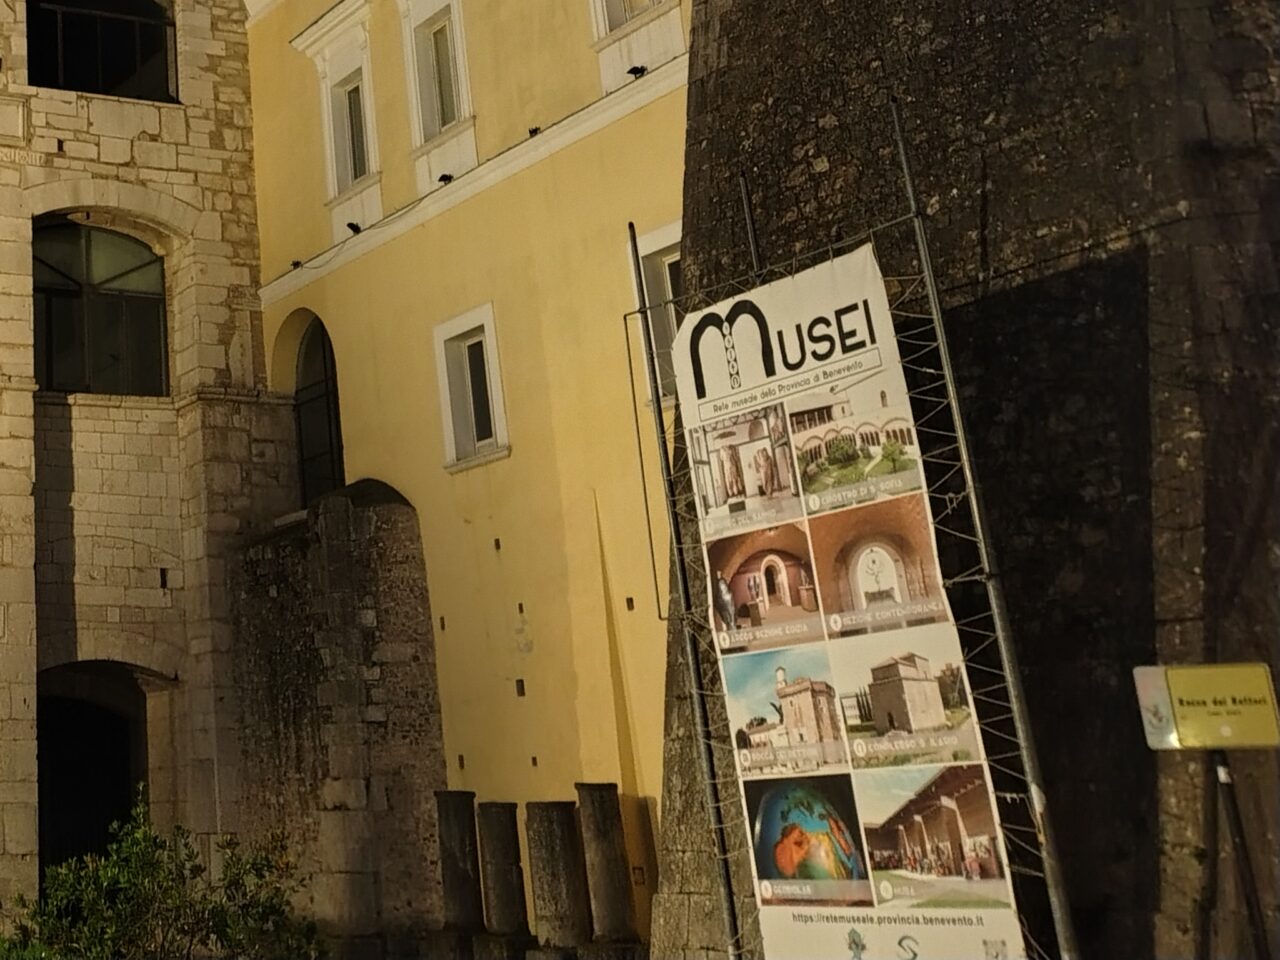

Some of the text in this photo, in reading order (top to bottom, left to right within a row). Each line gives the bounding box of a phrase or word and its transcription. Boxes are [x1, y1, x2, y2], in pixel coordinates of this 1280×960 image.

[690, 299, 877, 400] MUSEI
[731, 394, 758, 408] museale
[760, 388, 776, 400] della
[778, 376, 811, 393] Provincia
[813, 373, 820, 383] di
[823, 361, 863, 380] Benevento
[791, 912, 985, 927] https://retemuseale.provincia.benevento.it
